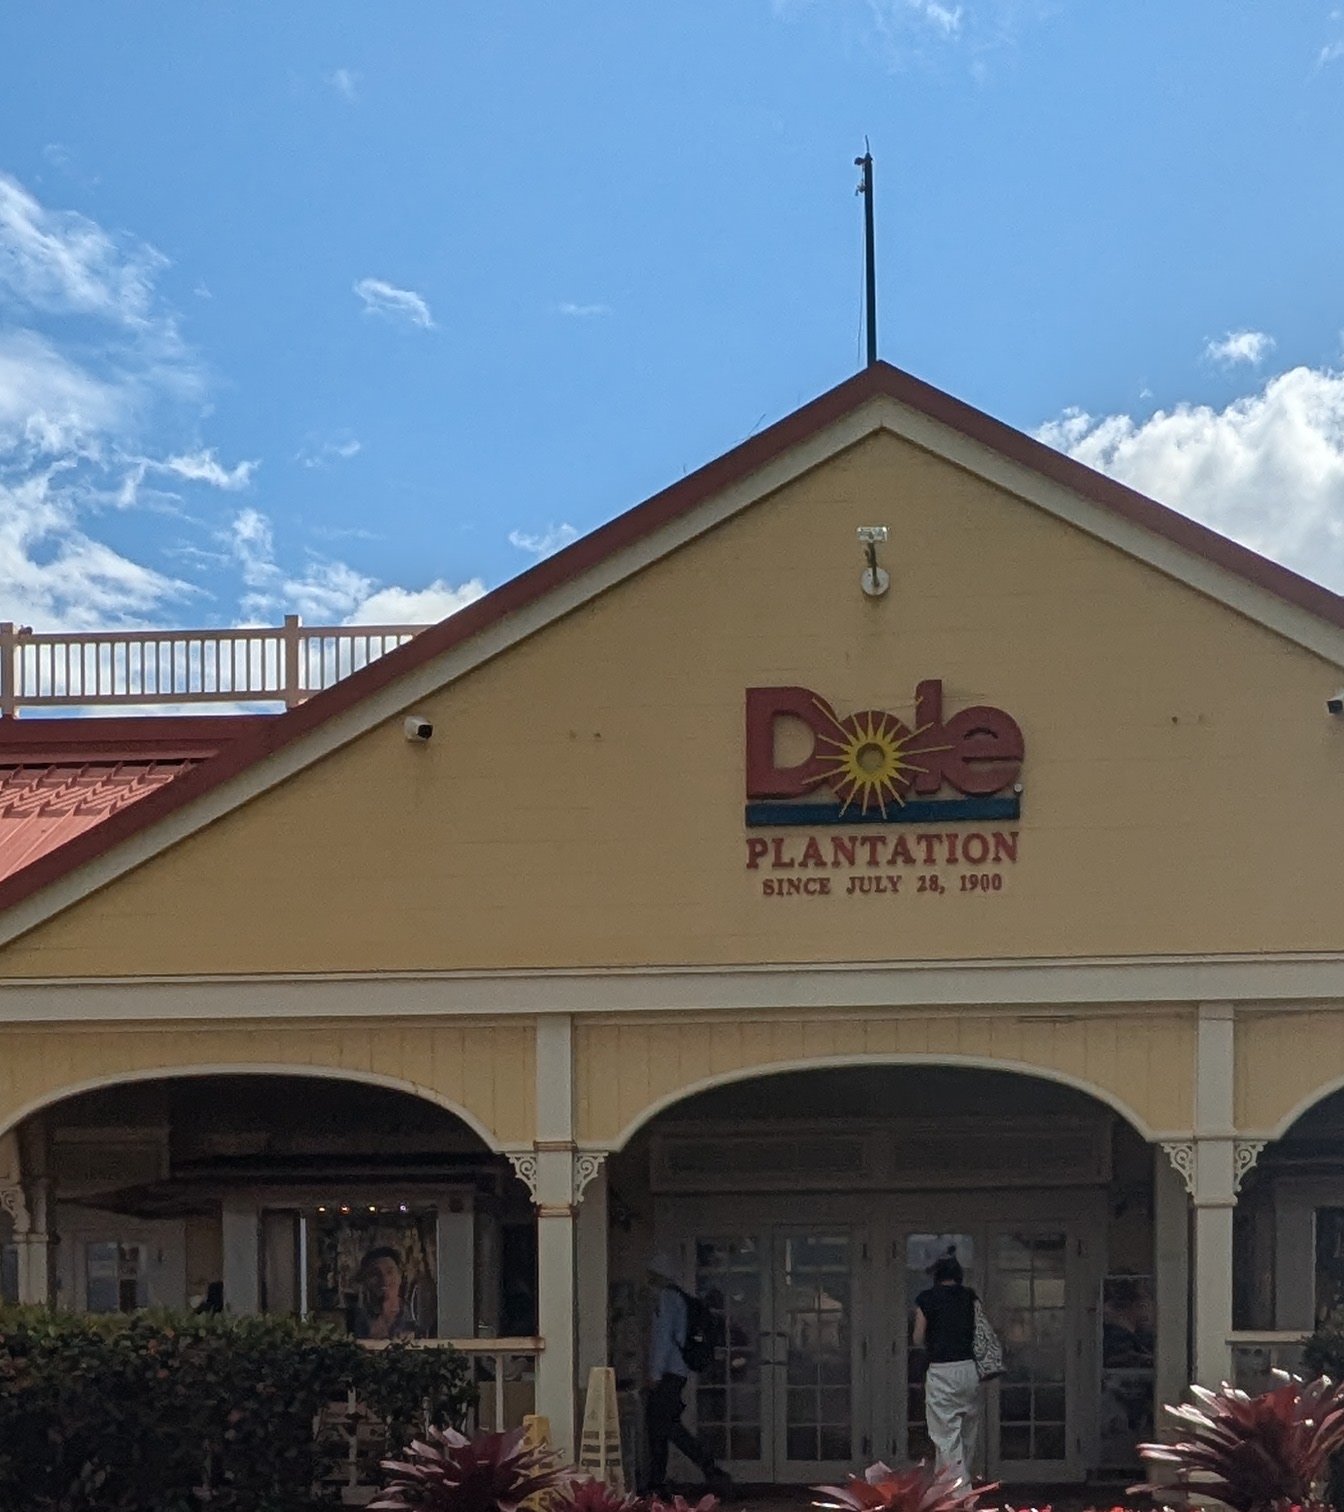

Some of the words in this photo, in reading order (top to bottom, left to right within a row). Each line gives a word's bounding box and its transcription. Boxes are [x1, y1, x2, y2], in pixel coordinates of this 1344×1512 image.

[745, 679, 1025, 808] Dole
[745, 832, 1019, 869] PLANTATION
[762, 877, 831, 896] SINCE
[846, 875, 902, 894] JULY
[916, 874, 946, 894] 28,
[959, 873, 1003, 892] 1900
